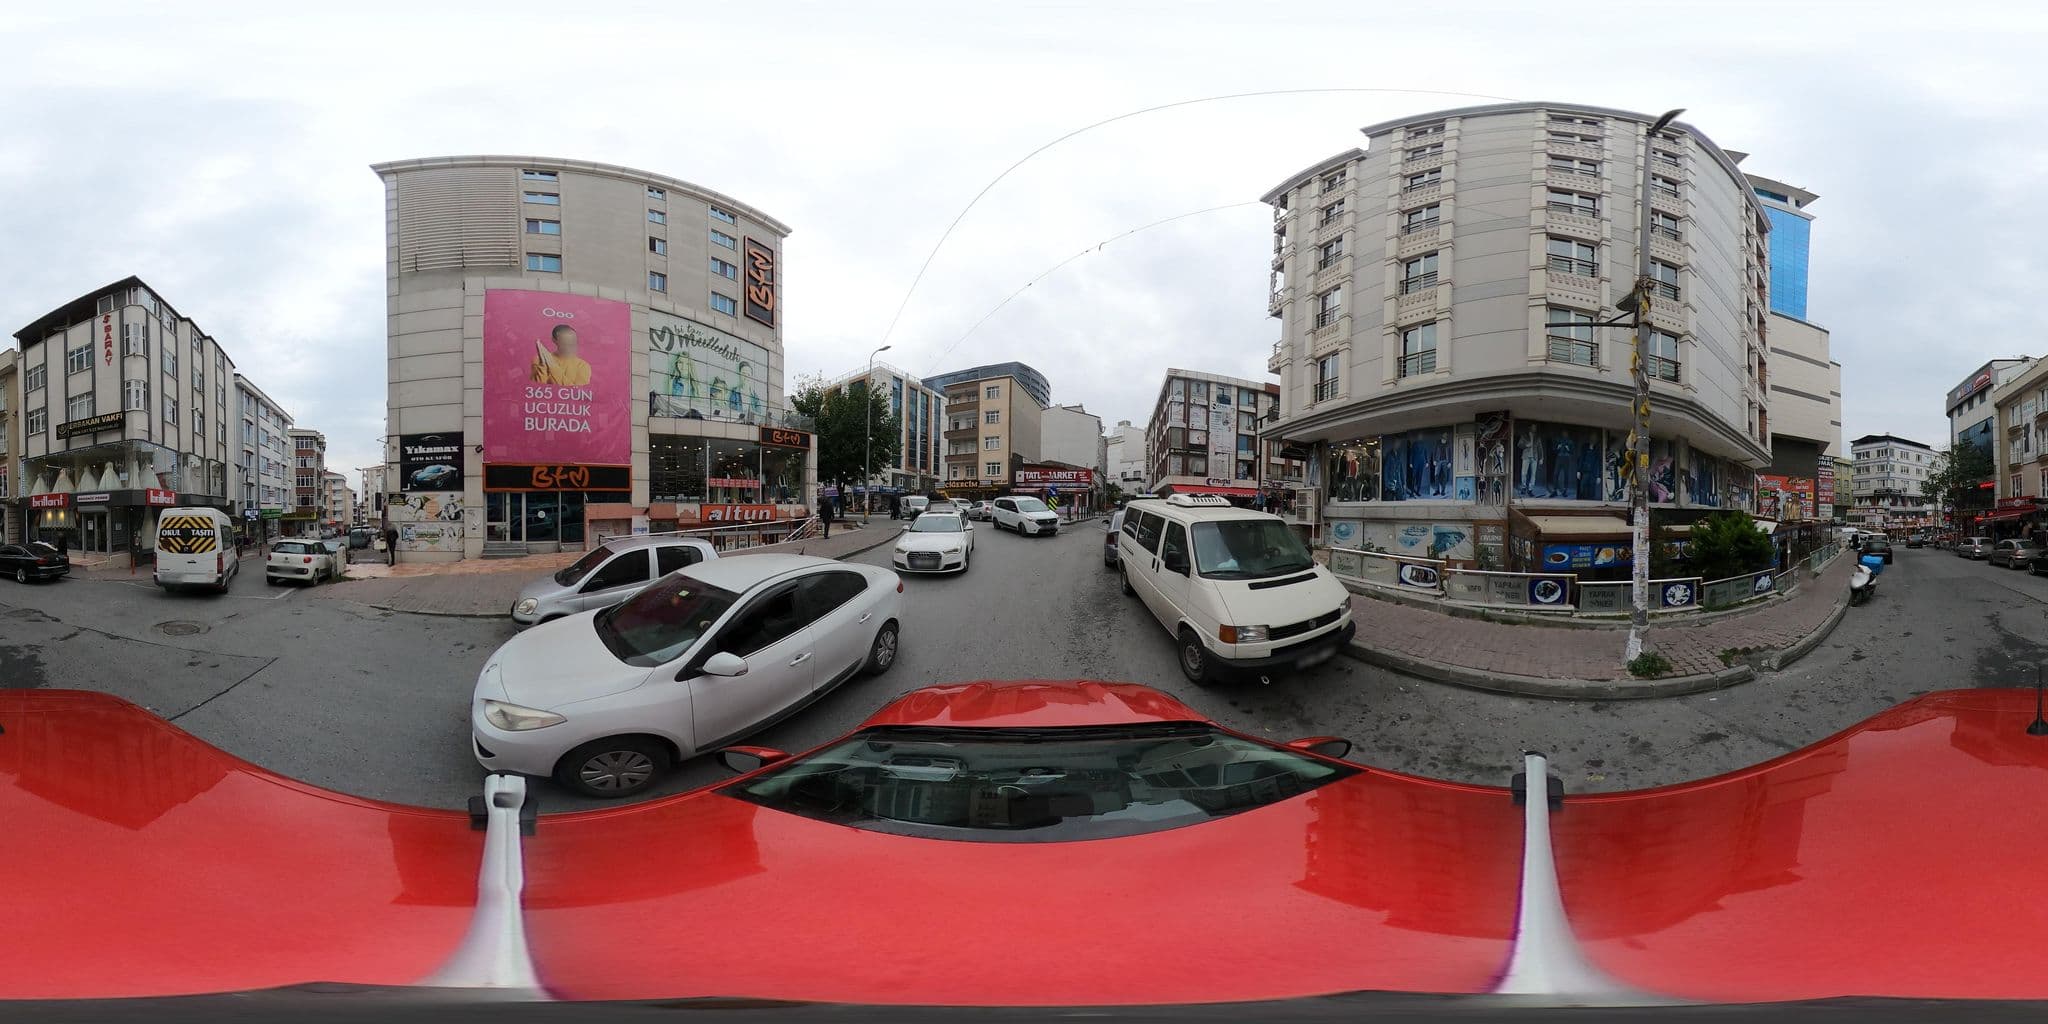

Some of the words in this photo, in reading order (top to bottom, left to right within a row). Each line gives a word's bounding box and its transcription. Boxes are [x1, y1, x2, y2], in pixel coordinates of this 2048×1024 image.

[525, 387, 552, 399] 365
[558, 386, 592, 401] GÜN
[524, 402, 591, 416] UCUZLUK
[524, 418, 591, 433] BURADA
[32, 494, 64, 507] brillant
[708, 505, 771, 521] altun
